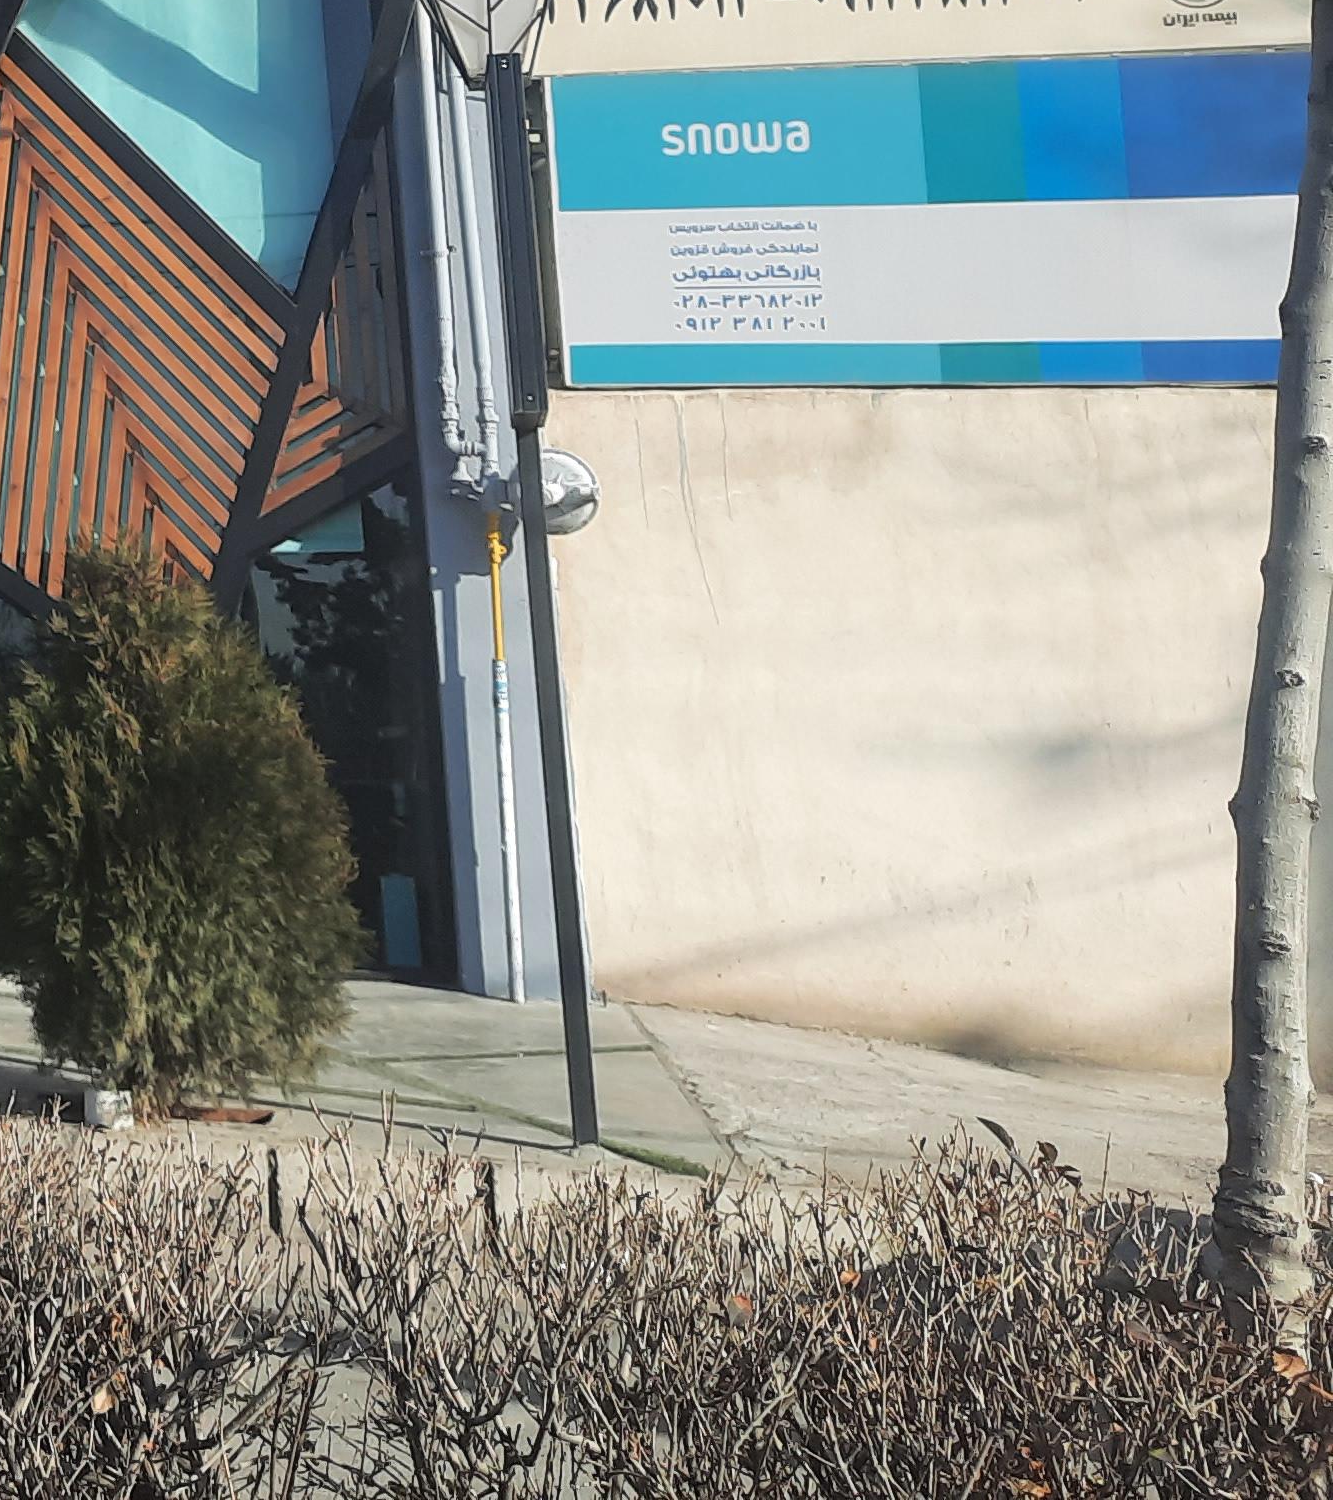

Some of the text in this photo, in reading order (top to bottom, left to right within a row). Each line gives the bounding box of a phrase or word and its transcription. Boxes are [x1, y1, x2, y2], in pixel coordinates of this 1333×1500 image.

[1162, 11, 1238, 28] بیمه ایران
[661, 118, 811, 157] snowa
[669, 242, 820, 257] نمایندگی فروش قزوین
[745, 263, 821, 282] بازرگانی
